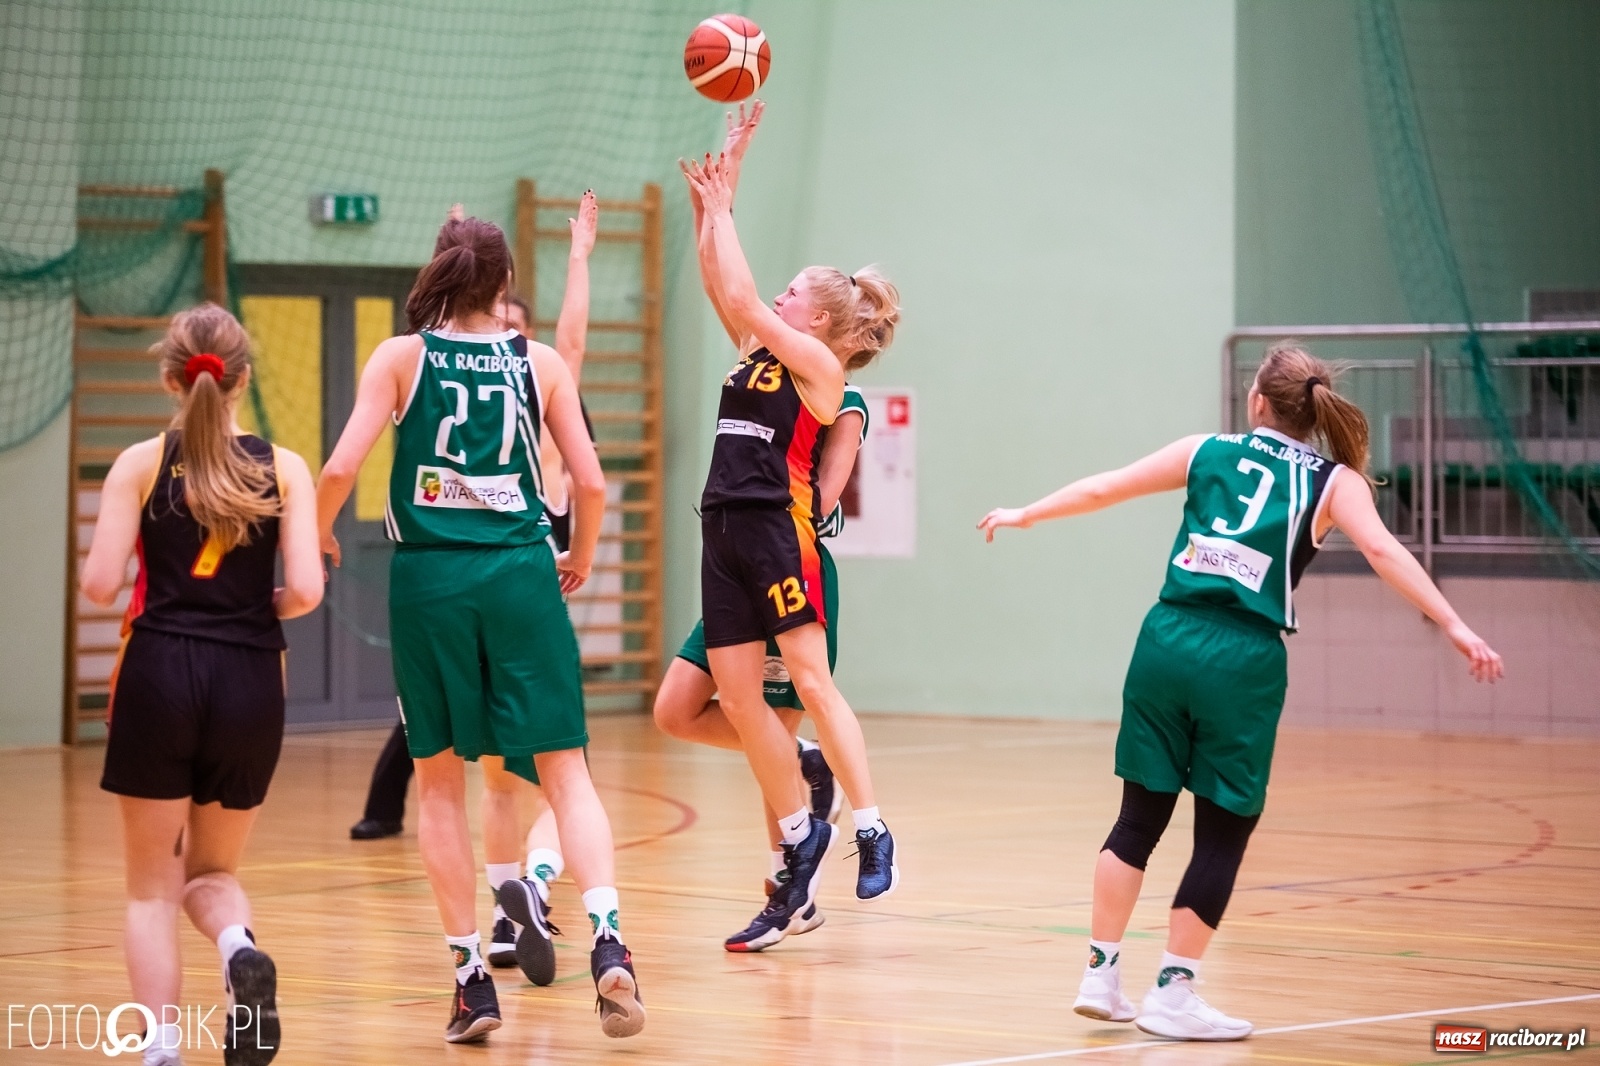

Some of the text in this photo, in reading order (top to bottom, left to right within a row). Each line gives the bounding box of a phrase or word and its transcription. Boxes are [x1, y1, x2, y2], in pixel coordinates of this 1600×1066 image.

[746, 361, 783, 393] 13
[435, 380, 517, 465] 27
[1211, 457, 1275, 536] 3
[767, 576, 807, 618] 13
